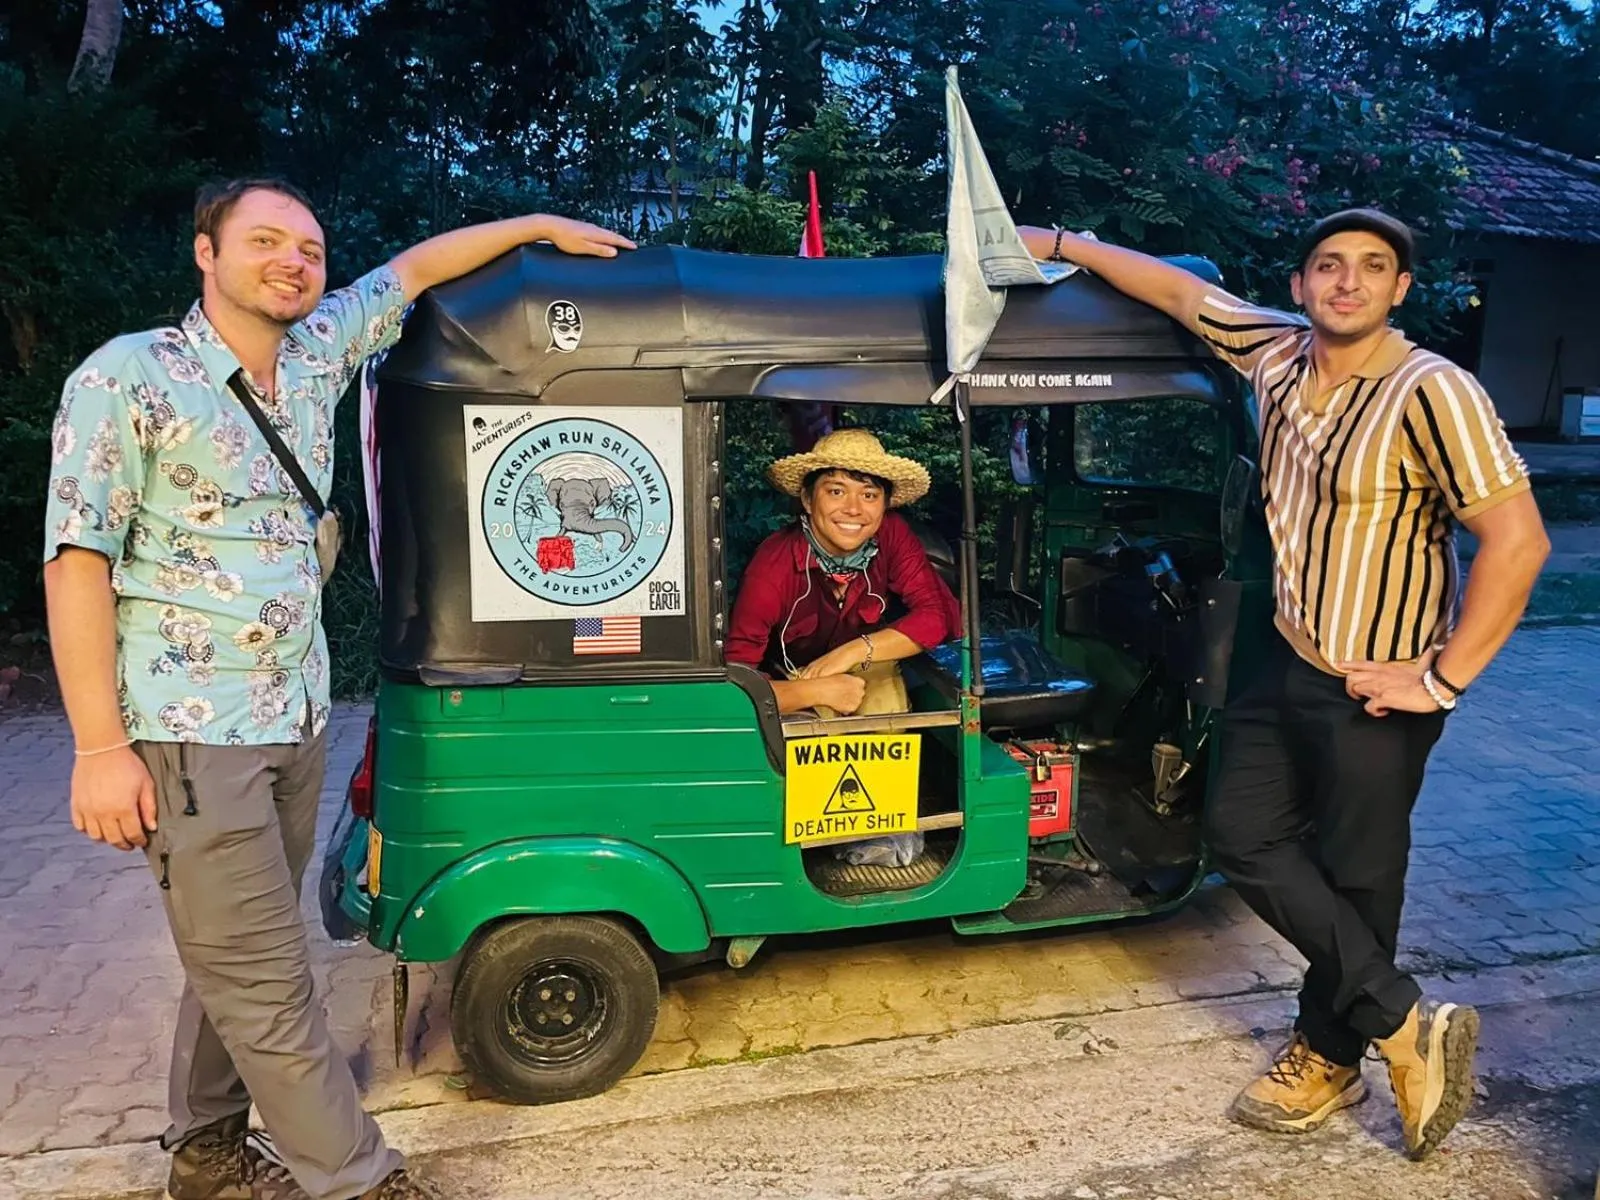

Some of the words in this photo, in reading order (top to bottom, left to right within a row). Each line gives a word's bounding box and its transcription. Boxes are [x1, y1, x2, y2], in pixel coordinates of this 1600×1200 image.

[554, 305, 576, 321] 38
[1009, 374, 1036, 387] YOU
[1038, 374, 1072, 387] COME
[1075, 374, 1112, 387] AGAIN
[491, 418, 503, 429] THE
[471, 411, 533, 454] ADVENTURISTS
[494, 436, 551, 507] RICKSHAW
[559, 432, 594, 445] RUN
[601, 437, 628, 459] SRI
[629, 458, 662, 506] LANKA
[490, 522, 514, 538] 20
[645, 520, 667, 536] 24
[513, 557, 538, 581] THE
[543, 555, 647, 595] ADVENTURISTS
[648, 580, 681, 593] COOL
[649, 592, 681, 610] EARTH
[794, 741, 911, 766] WARNING!
[793, 815, 859, 838] DEATHY
[866, 812, 906, 830] SHIT
